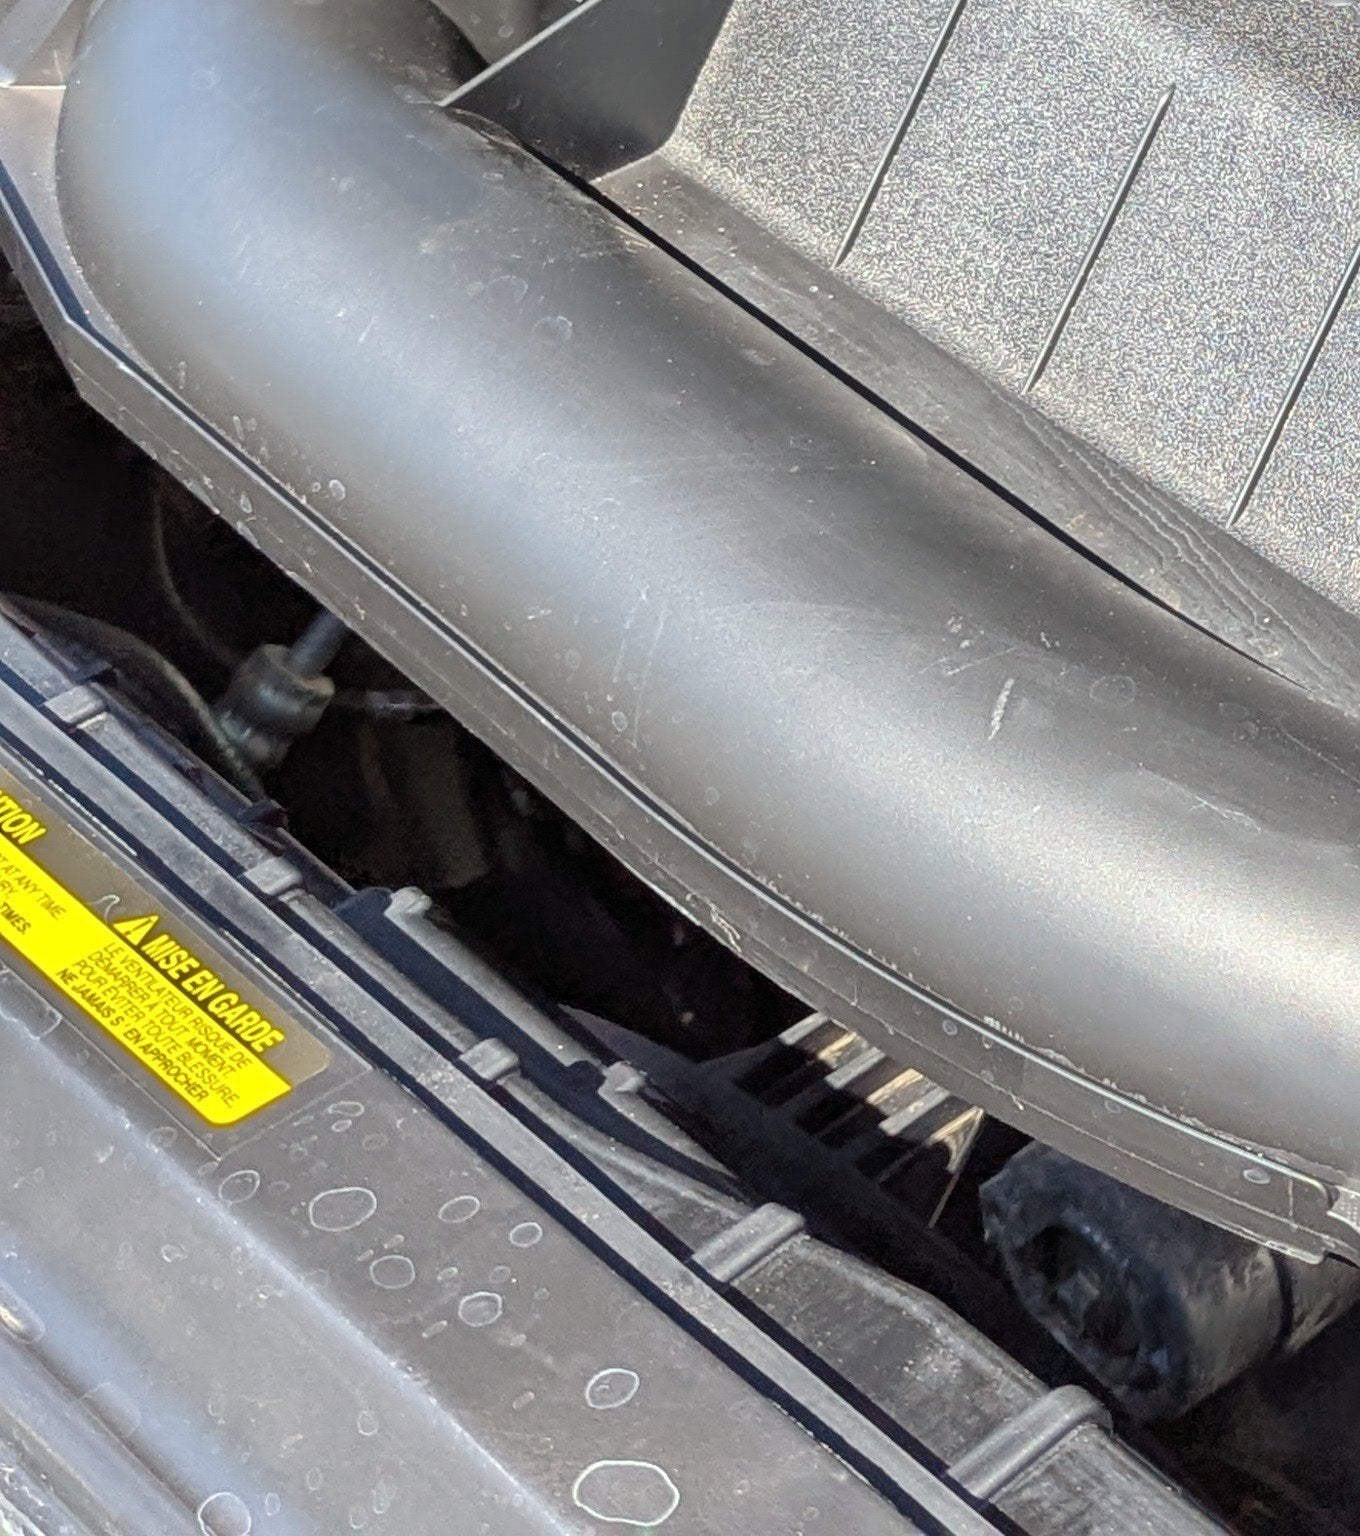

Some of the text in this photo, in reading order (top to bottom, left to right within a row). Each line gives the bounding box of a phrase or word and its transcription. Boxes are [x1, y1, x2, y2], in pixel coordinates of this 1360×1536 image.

[0, 790, 47, 845] TION
[35, 891, 68, 921] TIME
[55, 967, 79, 986] NE
[71, 983, 118, 1019] JAMAIS
[140, 1041, 210, 1104] APPROCHER
[72, 958, 109, 988] POUR
[142, 1018, 183, 1055] TOUTE
[103, 941, 254, 1070] LE VENTILATEUR RISQUE DE
[141, 934, 286, 1053] MISE EN GARDE
[155, 1008, 191, 1037] TOUT
